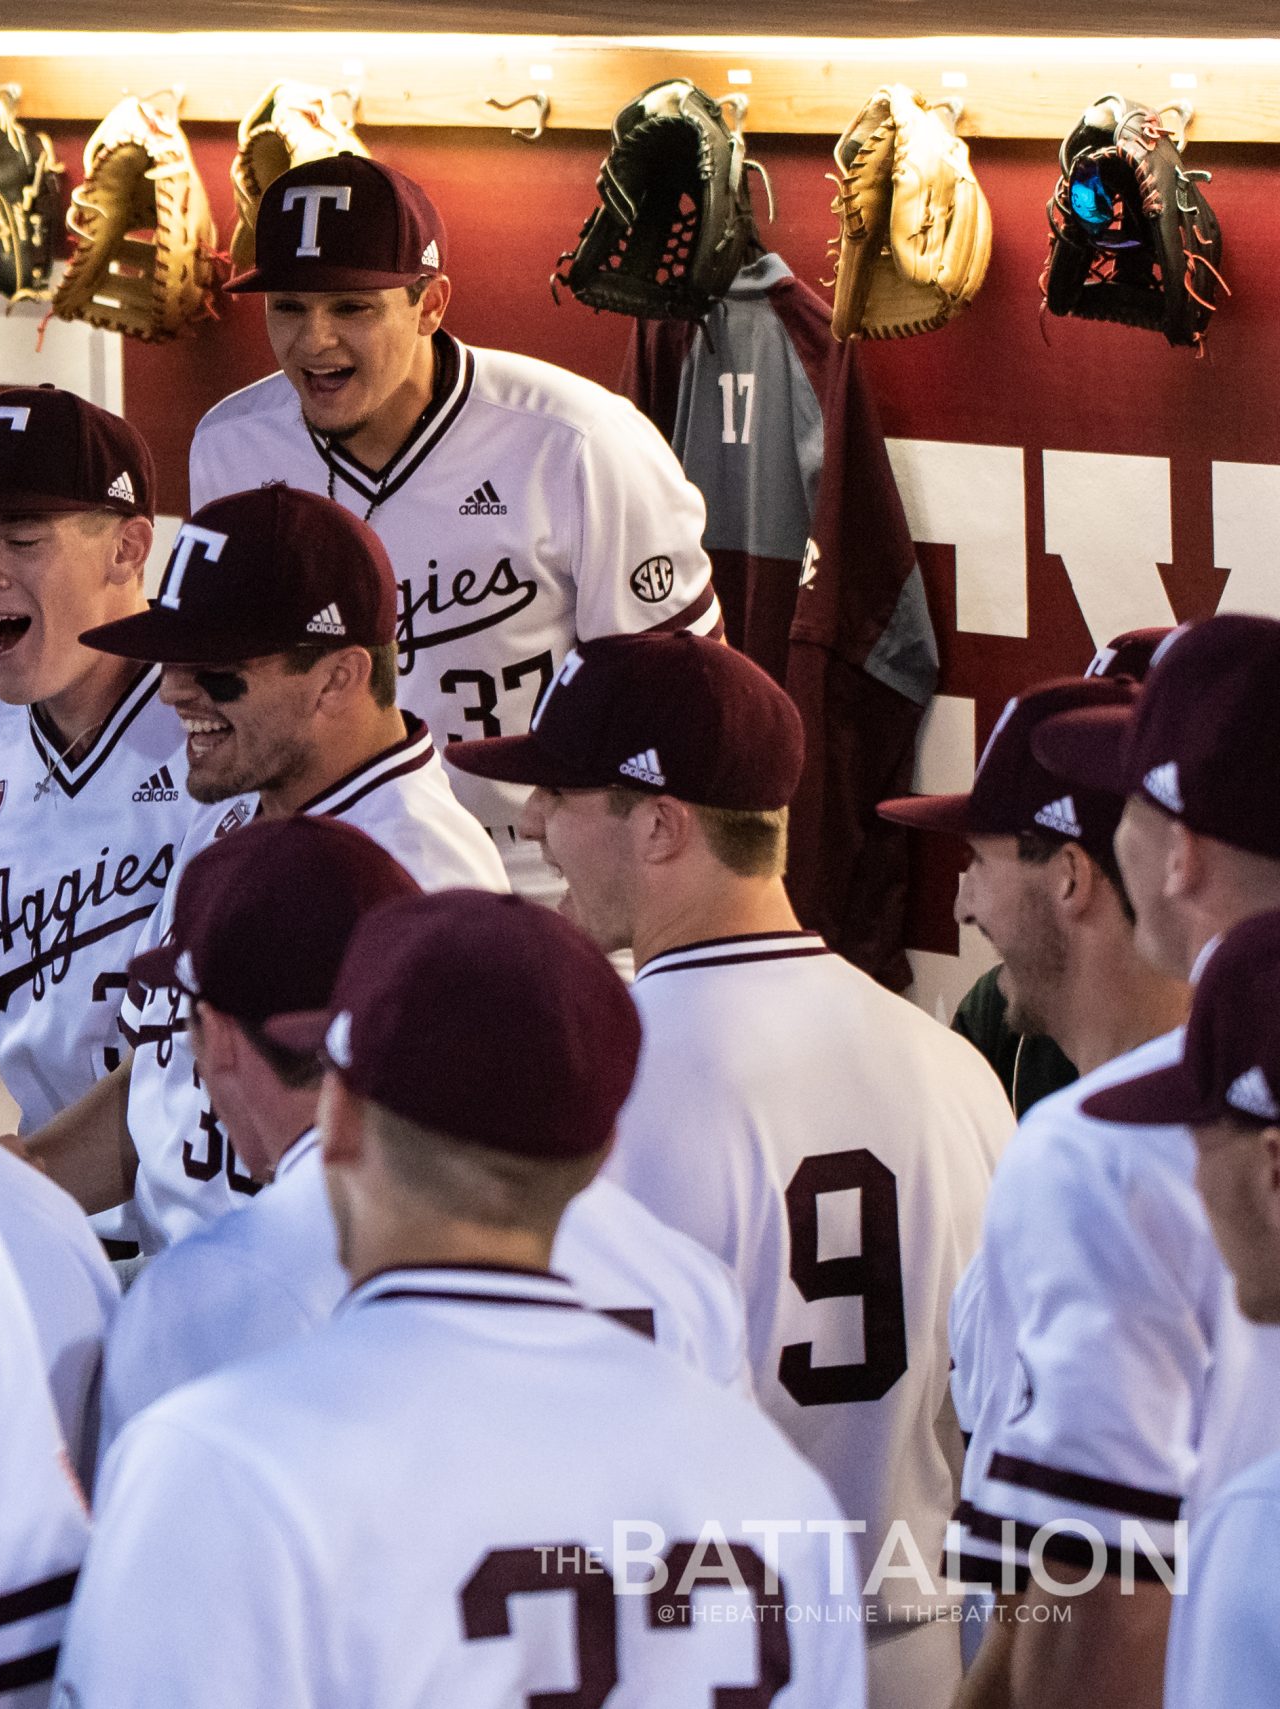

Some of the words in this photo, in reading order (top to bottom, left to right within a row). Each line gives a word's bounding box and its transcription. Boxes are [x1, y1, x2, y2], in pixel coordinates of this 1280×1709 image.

[282, 185, 351, 257] T
[718, 372, 756, 444] 17
[458, 501, 508, 515] adidas
[160, 523, 229, 610] T
[632, 556, 672, 602] SEC
[306, 619, 346, 636] adidas
[439, 650, 554, 742] 37
[131, 787, 180, 802] adidas
[778, 1148, 909, 1408] 9
